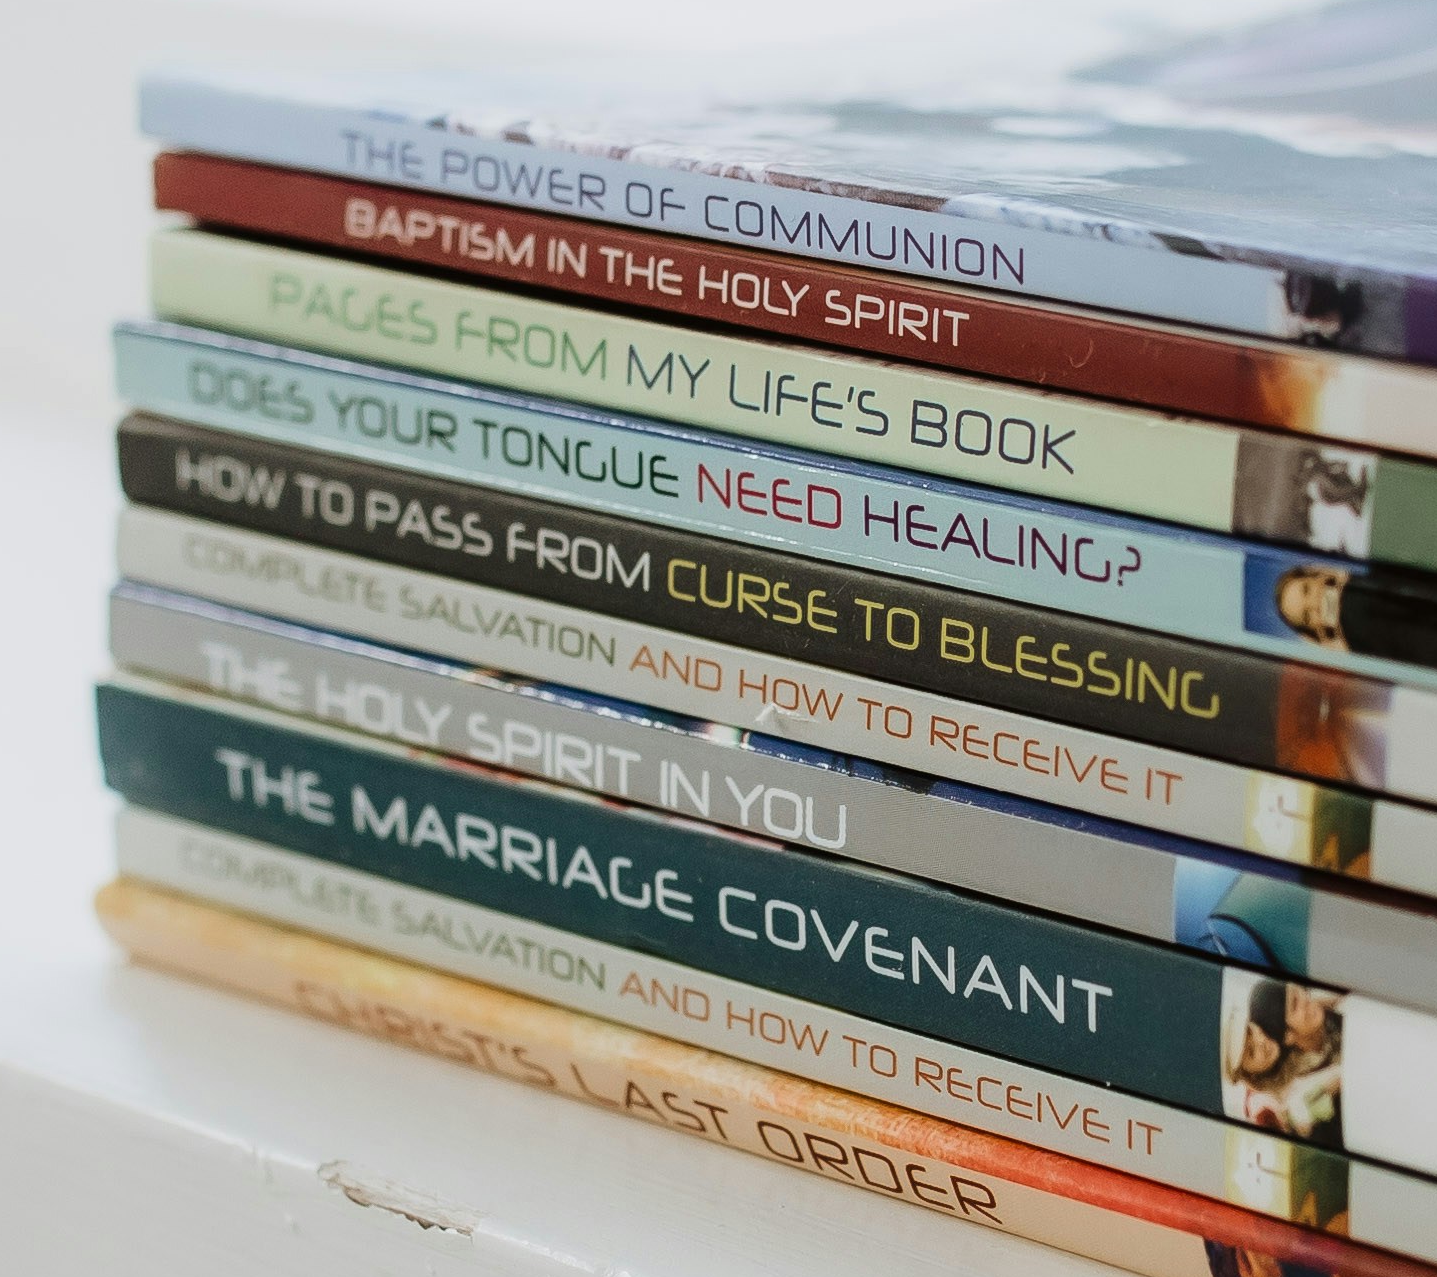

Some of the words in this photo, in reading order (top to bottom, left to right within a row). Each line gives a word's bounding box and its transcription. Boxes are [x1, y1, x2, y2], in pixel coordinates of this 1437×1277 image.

[342, 129, 424, 180] THE
[441, 146, 607, 211] POWER
[626, 181, 686, 222] OF
[705, 194, 1025, 285] COMMUNION
[345, 199, 534, 269] BAPTISM
[547, 239, 587, 279] IN
[599, 246, 683, 299] THE
[699, 265, 810, 318] HOLY
[825, 289, 970, 347] SPIRIT
[187, 359, 314, 421] DOES
[328, 389, 458, 451] YOUR
[473, 418, 679, 499] TONGUE
[697, 462, 843, 530] NEED
[864, 493, 1142, 588] HEALING?
[269, 273, 438, 346] PAGES
[456, 311, 608, 380] FROM
[627, 343, 711, 399] MY
[729, 363, 890, 437] LIFE'S
[910, 399, 1077, 475] BOOK
[174, 448, 286, 511] HOW
[295, 474, 354, 527] TO
[365, 491, 493, 558] PASS
[507, 522, 650, 593] FROM
[667, 558, 838, 634] CURSE
[855, 597, 921, 651] TO
[940, 617, 1222, 720] BLESSING
[182, 530, 386, 614] COMPLETE
[399, 584, 616, 668] SALVATION
[629, 643, 723, 693] AND
[738, 668, 844, 721] HOW
[857, 696, 913, 740] TO
[929, 715, 1131, 794] RECEIVE
[1145, 766, 1184, 807] IT
[203, 640, 303, 712] THE
[316, 673, 453, 748] HOLY
[466, 710, 641, 798] SPIRIT
[660, 758, 710, 818] IN
[724, 780, 847, 849] YOU
[178, 837, 380, 921] COMPLETE
[390, 898, 606, 992] SALVATION
[618, 970, 710, 1023] AND
[726, 1001, 830, 1058] HOW
[842, 1033, 898, 1080] TO
[913, 1056, 1111, 1141] RECEIVE
[1127, 1119, 1163, 1157] IT
[216, 747, 336, 826] THE
[351, 785, 694, 924] MARRIAGE
[718, 884, 1114, 1034] COVENANT
[293, 979, 556, 1089] CHRIST'S
[569, 1062, 730, 1143] LAST
[757, 1120, 1004, 1225] ORDER
